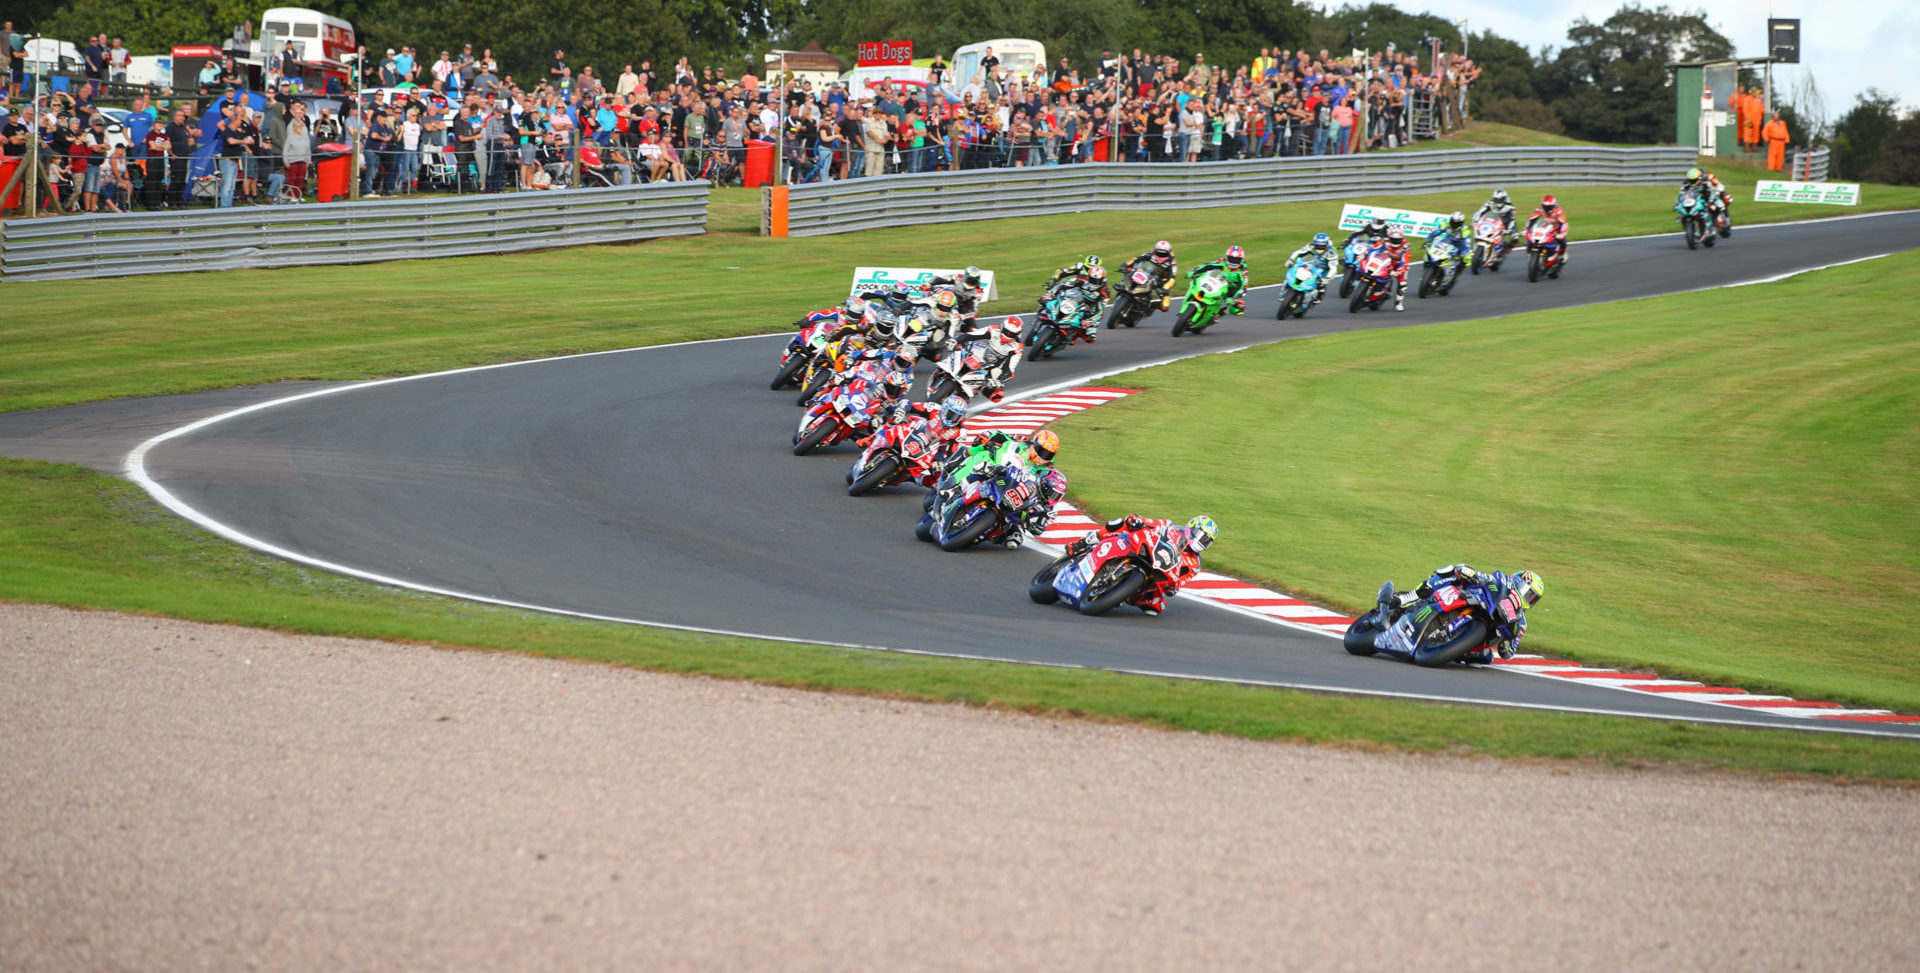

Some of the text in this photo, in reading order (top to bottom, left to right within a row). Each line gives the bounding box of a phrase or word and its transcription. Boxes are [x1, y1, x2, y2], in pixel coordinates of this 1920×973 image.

[858, 43, 910, 63] Hot Dogs
[1006, 489, 1023, 507] 95
